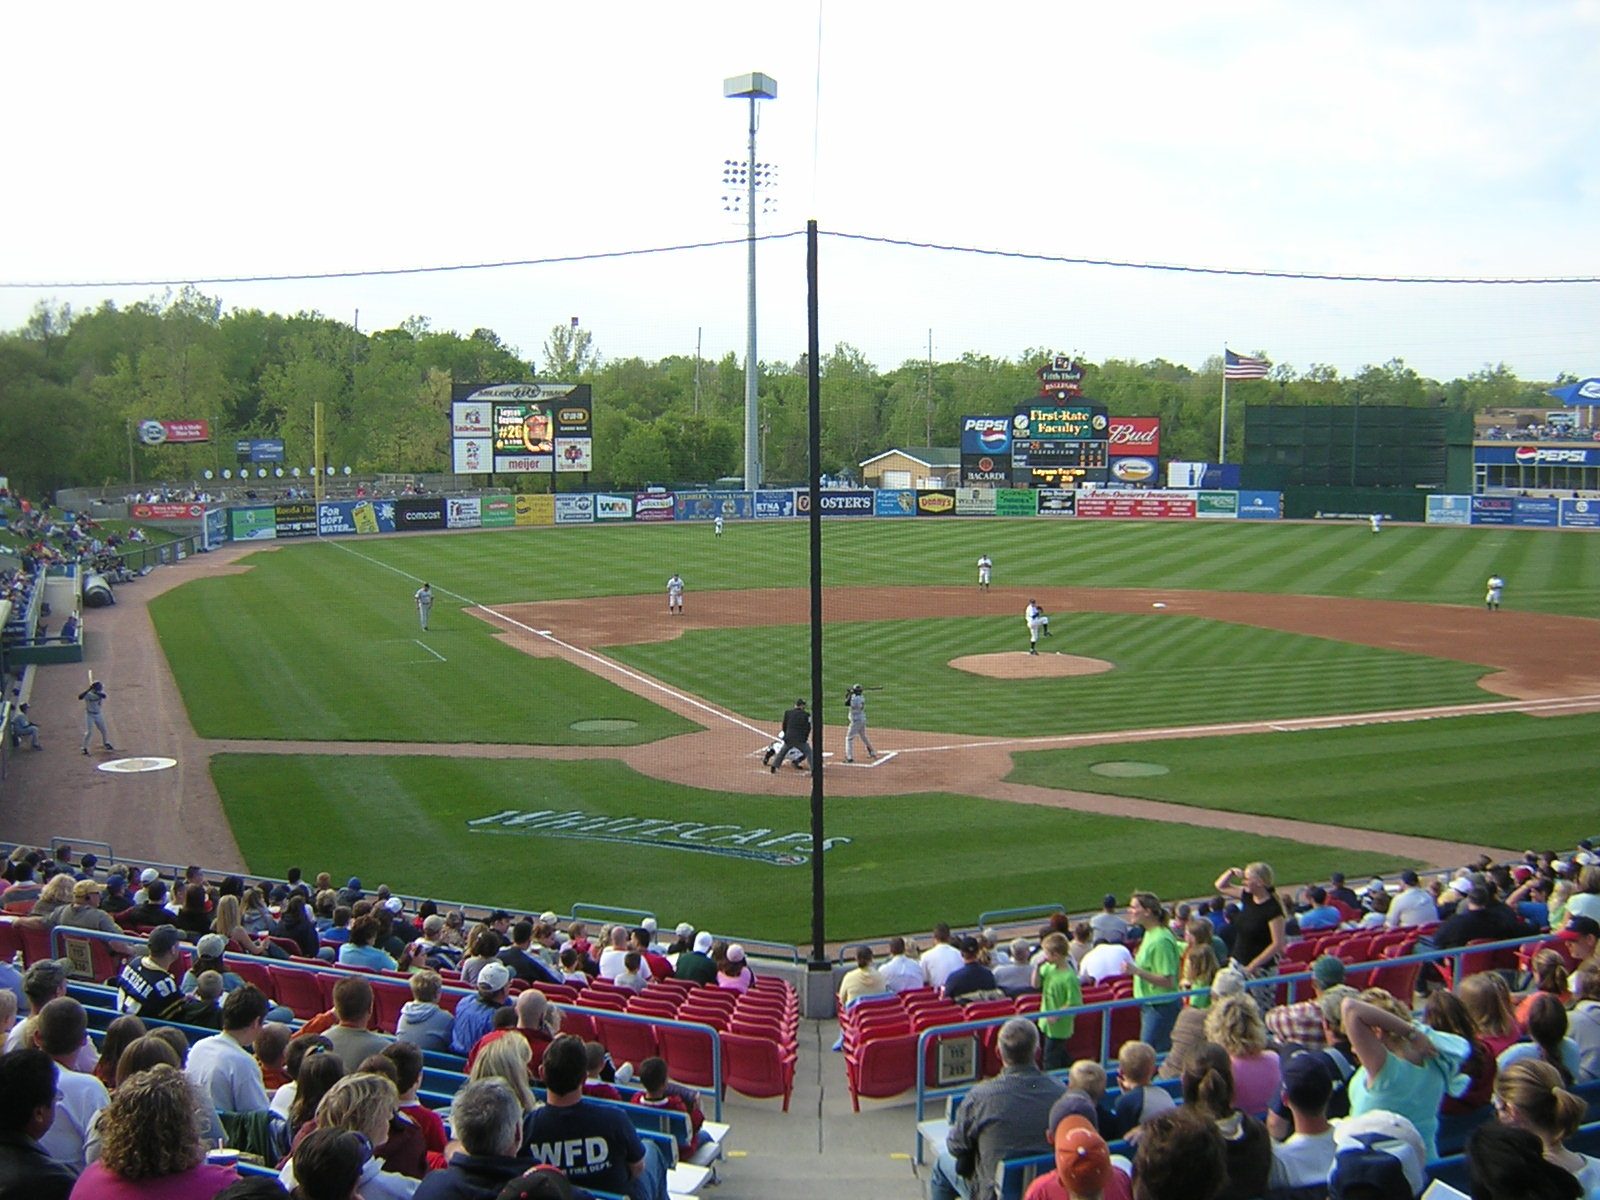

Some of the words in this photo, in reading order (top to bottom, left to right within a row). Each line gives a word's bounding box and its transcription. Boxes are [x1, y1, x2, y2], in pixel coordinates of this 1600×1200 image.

[964, 419, 1009, 432] PEPSI
[1037, 422, 1082, 436] Faculty
[1108, 424, 1159, 444] Bud
[1536, 449, 1587, 462] PEPSI
[508, 458, 540, 471] meijer
[967, 472, 1005, 481] BACARDI
[600, 503, 628, 511] WM
[820, 496, 872, 509] OSTER'S
[320, 505, 340, 516] FOR
[405, 510, 441, 520] comcast
[320, 516, 343, 525] SOFT
[529, 1136, 609, 1168] WFD
